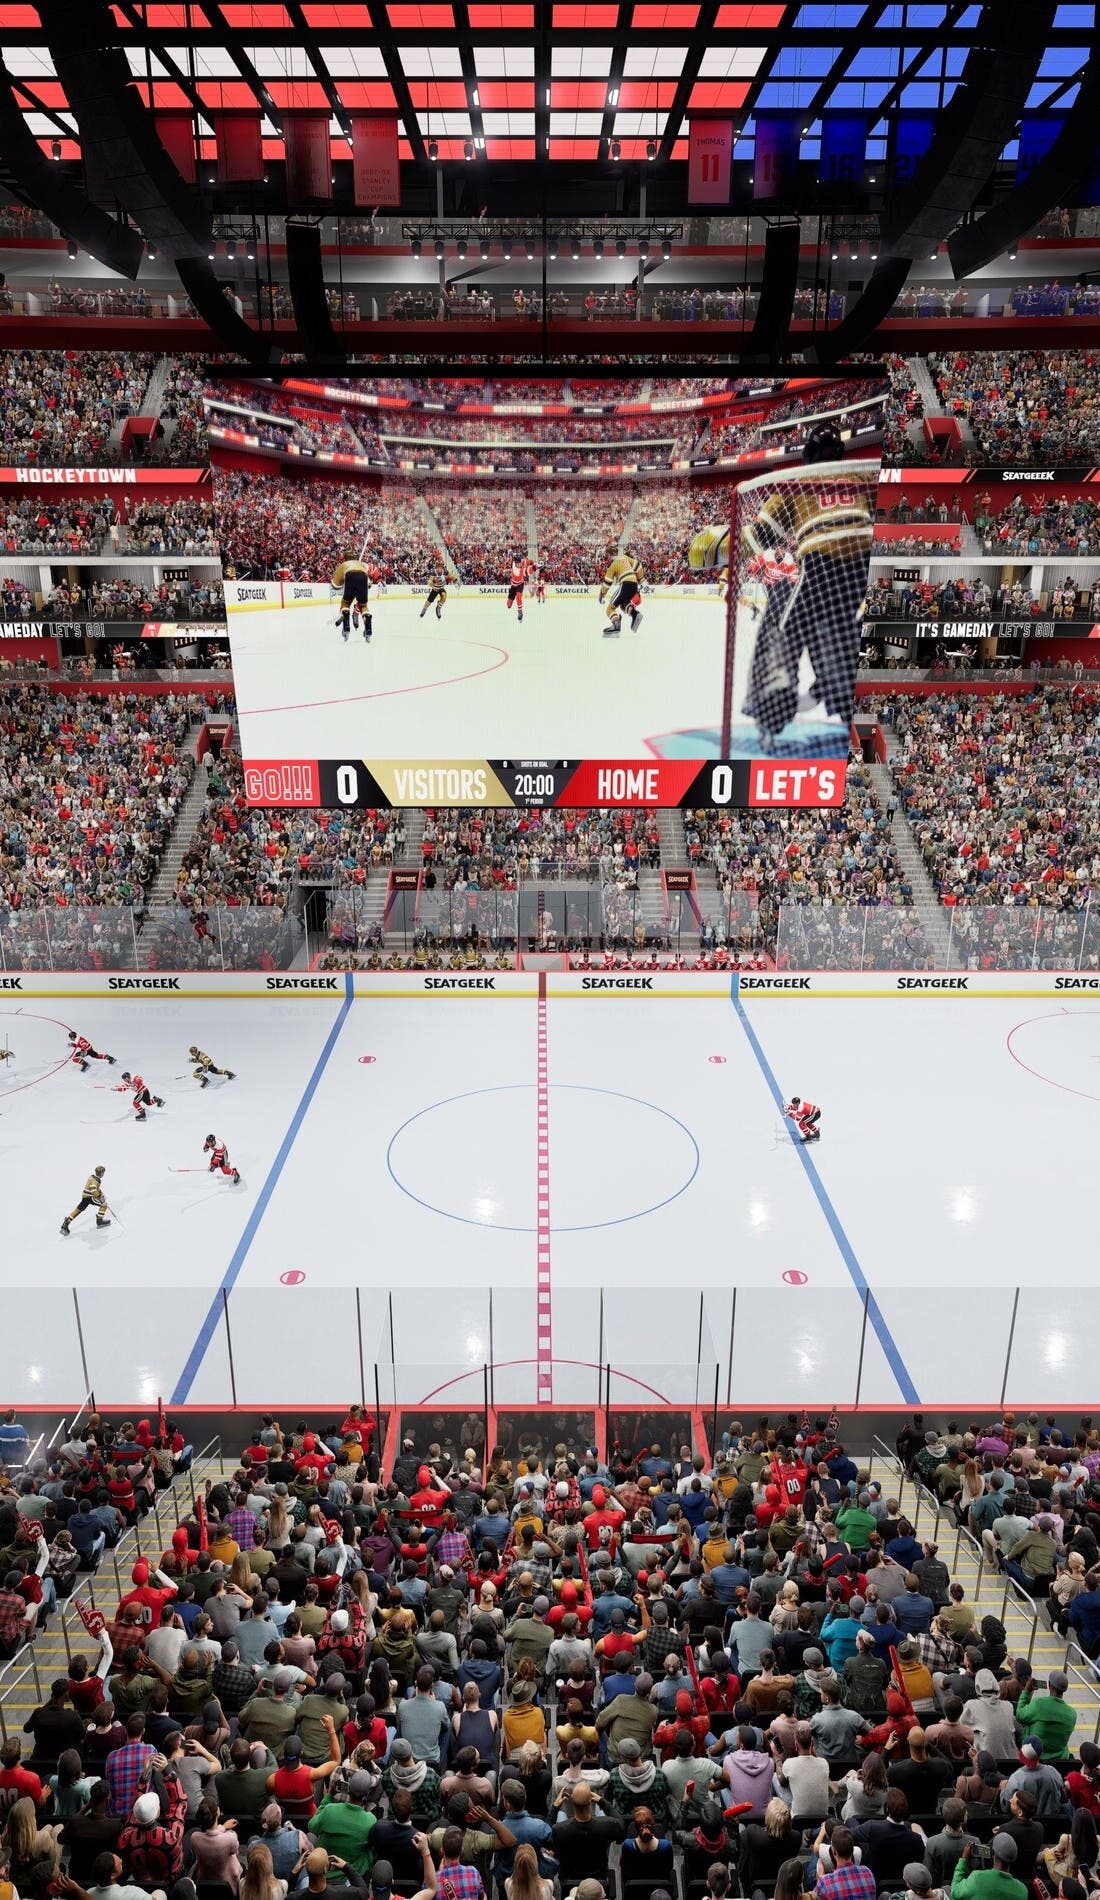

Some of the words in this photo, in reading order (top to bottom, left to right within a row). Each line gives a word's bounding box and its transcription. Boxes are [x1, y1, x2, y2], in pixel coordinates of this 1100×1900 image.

[696, 138, 726, 146] THOMAS
[701, 154, 719, 182] 11
[16, 468, 136, 483] HOCKEYTOWN
[237, 587, 267, 602] SEATGEEK
[50, 623, 81, 638] LET'S
[86, 623, 106, 638] GO!
[915, 623, 939, 638] IT'S
[943, 623, 994, 638] GAMEDAY
[999, 623, 1031, 638] LET'S
[1034, 623, 1055, 638] GO!
[245, 765, 313, 801] GO!!!
[336, 765, 359, 804] 0
[393, 768, 487, 800] VISITORS
[514, 774, 554, 796] 20:00
[597, 769, 660, 800] HOME
[711, 765, 733, 804] 0
[755, 766, 836, 801] LET'S
[108, 977, 181, 989] SEATGEEK
[266, 977, 338, 989] SEATGEEK
[424, 977, 496, 989] SEATGEEK
[582, 977, 653, 989] SEATGEEK
[739, 977, 811, 989] SEATGEEK
[897, 977, 969, 989] SEATGEEK
[786, 1478, 801, 1495] 00
